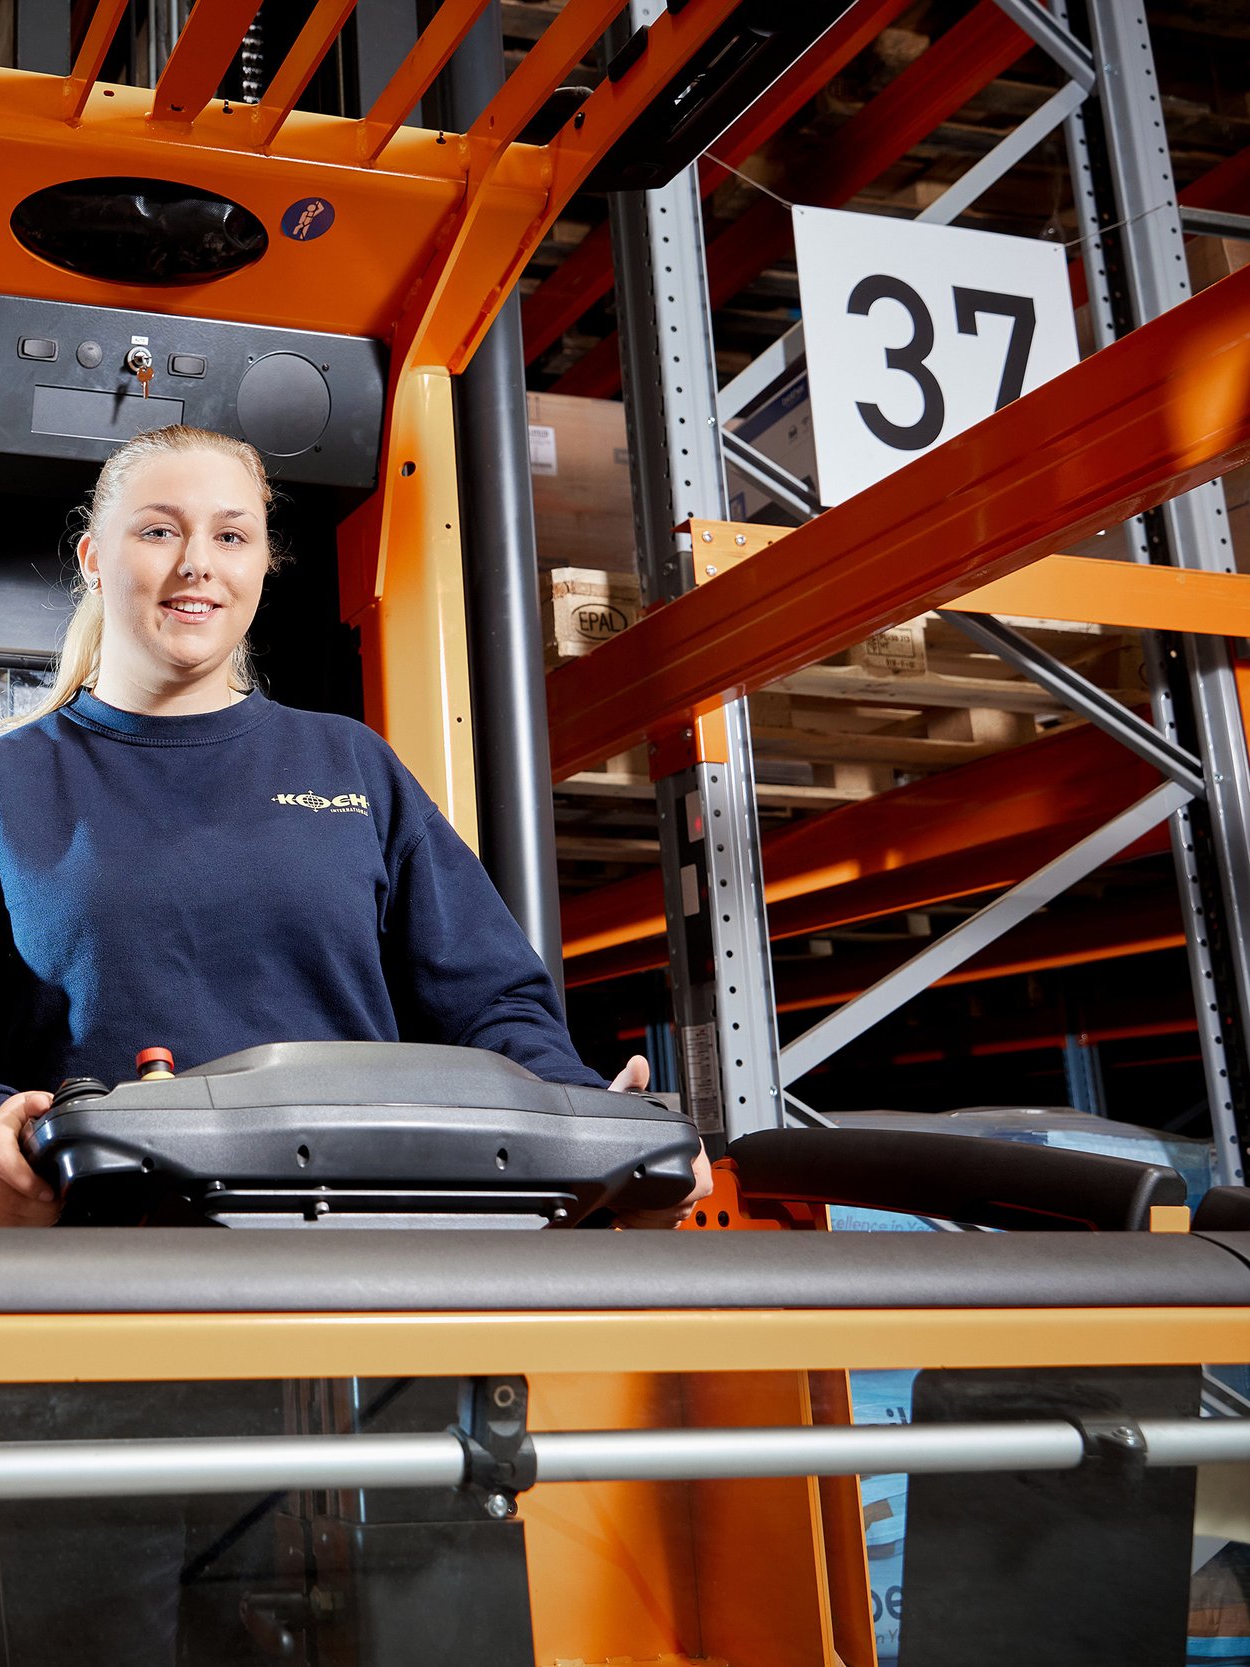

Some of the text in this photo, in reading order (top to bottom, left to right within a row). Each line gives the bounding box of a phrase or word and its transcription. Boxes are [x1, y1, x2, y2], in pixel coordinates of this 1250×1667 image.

[846, 274, 1036, 451] 37
[578, 611, 621, 632] EPAL
[275, 792, 369, 810] KOCH
